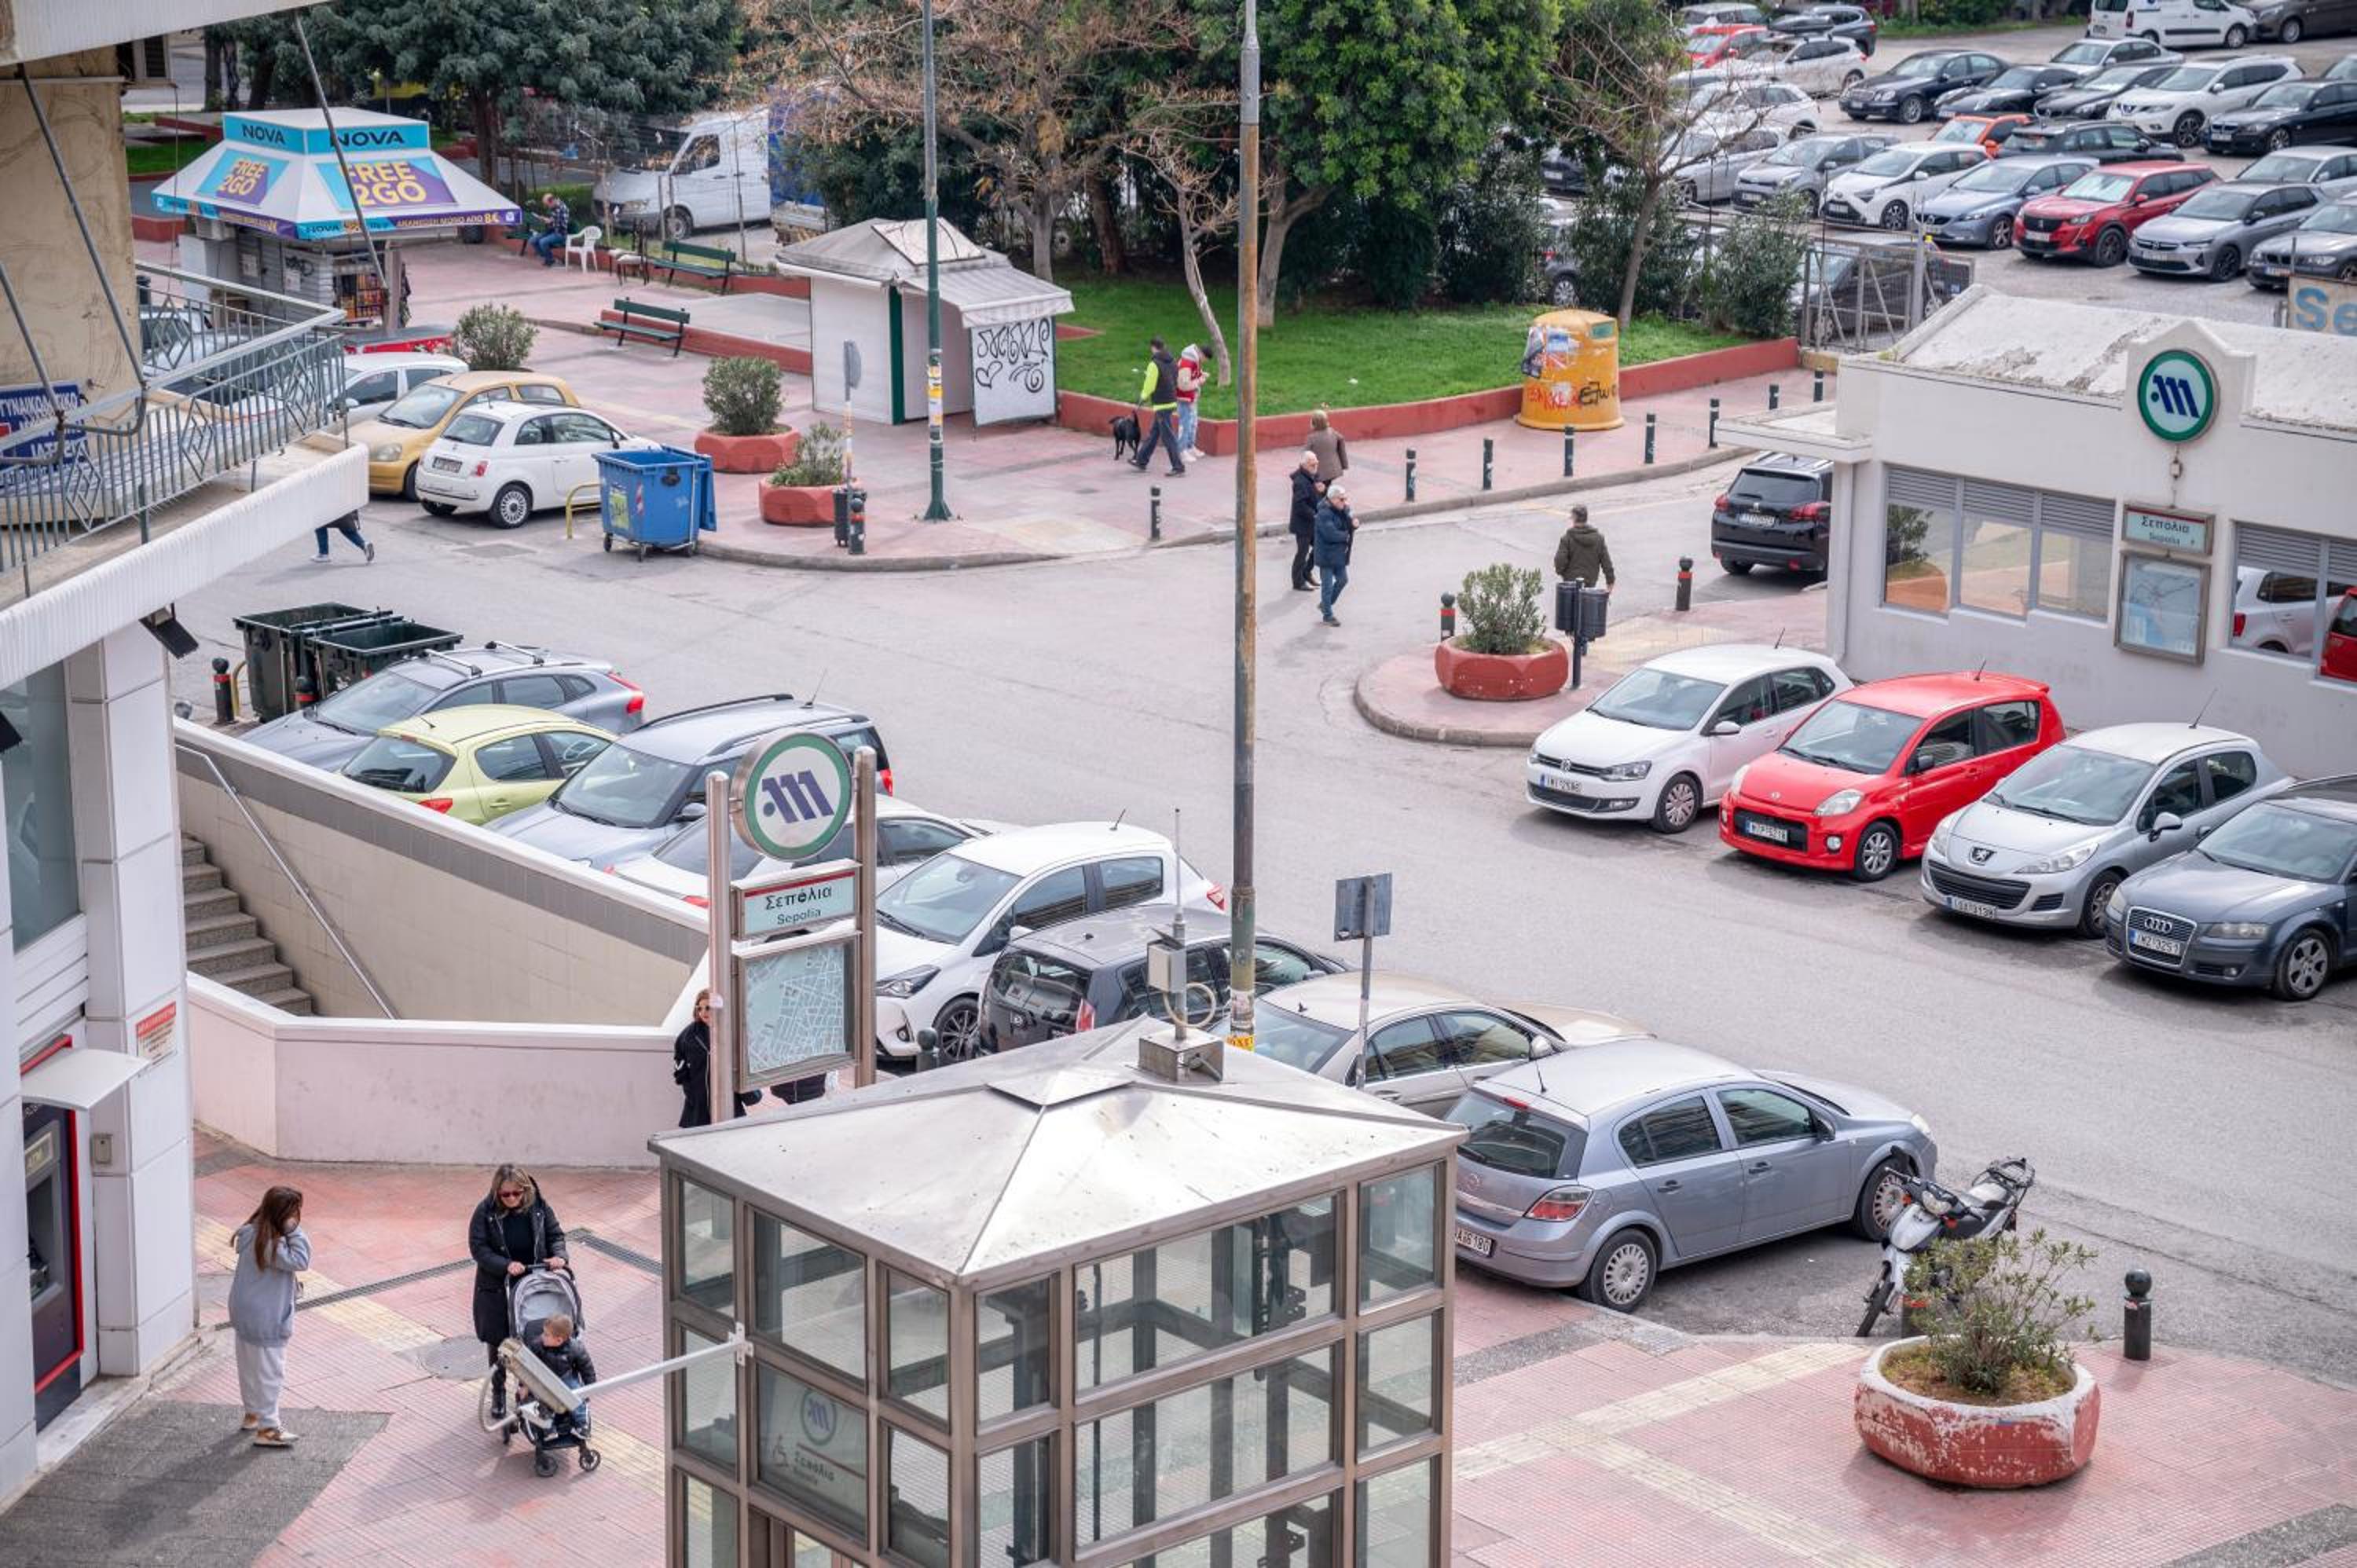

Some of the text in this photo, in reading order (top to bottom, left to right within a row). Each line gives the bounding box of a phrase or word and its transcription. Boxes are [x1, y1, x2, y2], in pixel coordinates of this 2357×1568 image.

[240, 124, 286, 145] NOVA
[330, 130, 405, 148] NOVA
[218, 174, 257, 196] 2GO
[354, 181, 427, 206] 2GO
[765, 886, 832, 910] Σεπόλια
[777, 908, 822, 925] Sepolia
